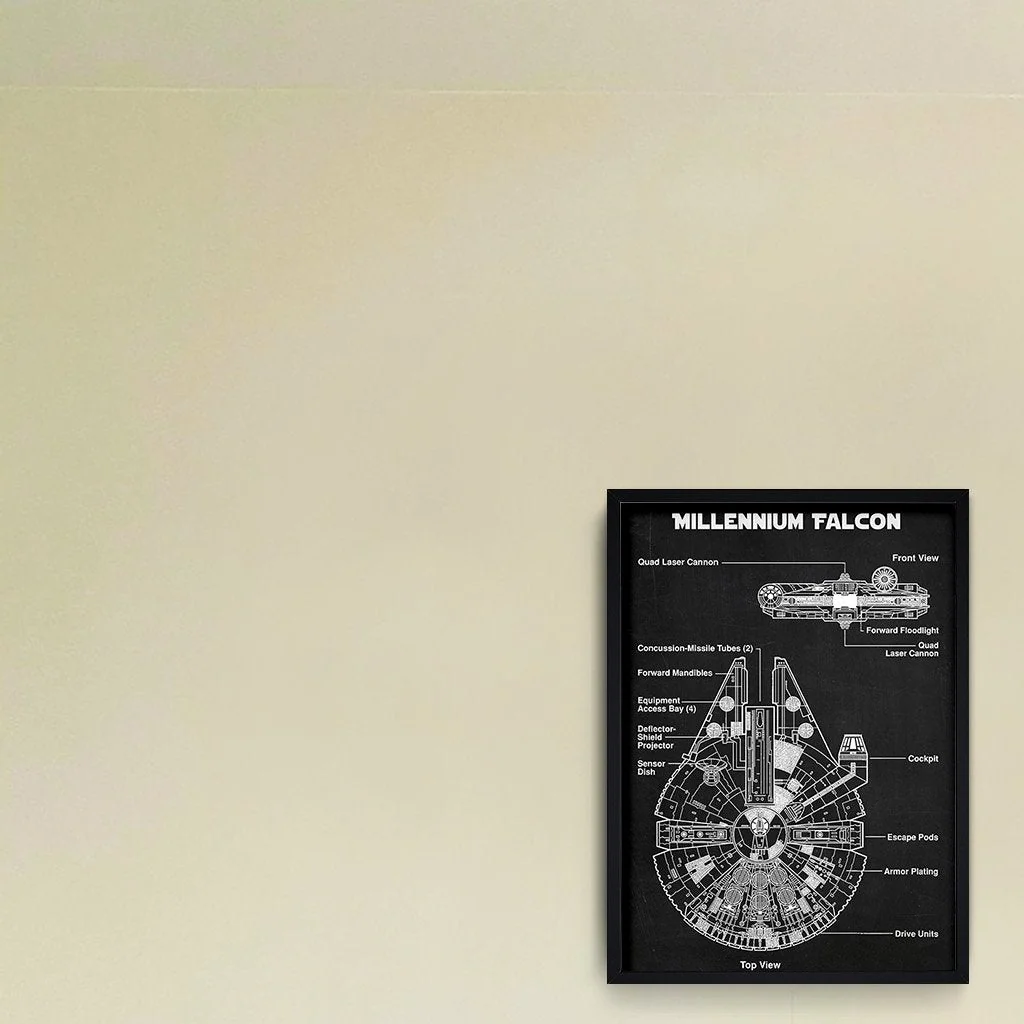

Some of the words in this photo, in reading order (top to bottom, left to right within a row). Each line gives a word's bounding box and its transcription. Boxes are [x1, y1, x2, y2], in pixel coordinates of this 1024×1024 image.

[672, 513, 803, 530] MILLENNIUM
[812, 513, 900, 530] FALCON
[637, 557, 660, 566] Quad
[661, 558, 686, 566] Laser
[686, 557, 719, 566] Cannon
[892, 553, 916, 562] Front
[917, 553, 940, 563] View
[866, 626, 899, 635] Forward
[899, 626, 940, 636] Floodlight
[637, 644, 716, 653] Concussion-Missile
[716, 644, 742, 653] Tubes
[742, 644, 754, 654] (2)
[917, 641, 939, 650] Quad
[885, 649, 908, 658] Laser
[908, 649, 939, 658] Cannon
[637, 668, 671, 677] Forward
[672, 668, 713, 677] Mandibles
[637, 696, 681, 707] Equipment
[637, 705, 667, 714] Access
[668, 704, 685, 715] Bay
[685, 704, 697, 714] (4)
[637, 724, 677, 734] Deflector-
[637, 732, 663, 742] Shield
[637, 741, 675, 751] Projector
[637, 759, 666, 769] Sensor
[907, 754, 939, 765] Cockpit
[637, 767, 656, 777] Dish
[886, 833, 917, 843] Escape
[918, 833, 939, 842] Pods
[883, 867, 910, 876] Armor
[910, 867, 939, 878] Plating
[894, 929, 917, 938] Drive
[917, 929, 939, 938] Units
[739, 960, 758, 971] Top
[759, 960, 782, 970] View
